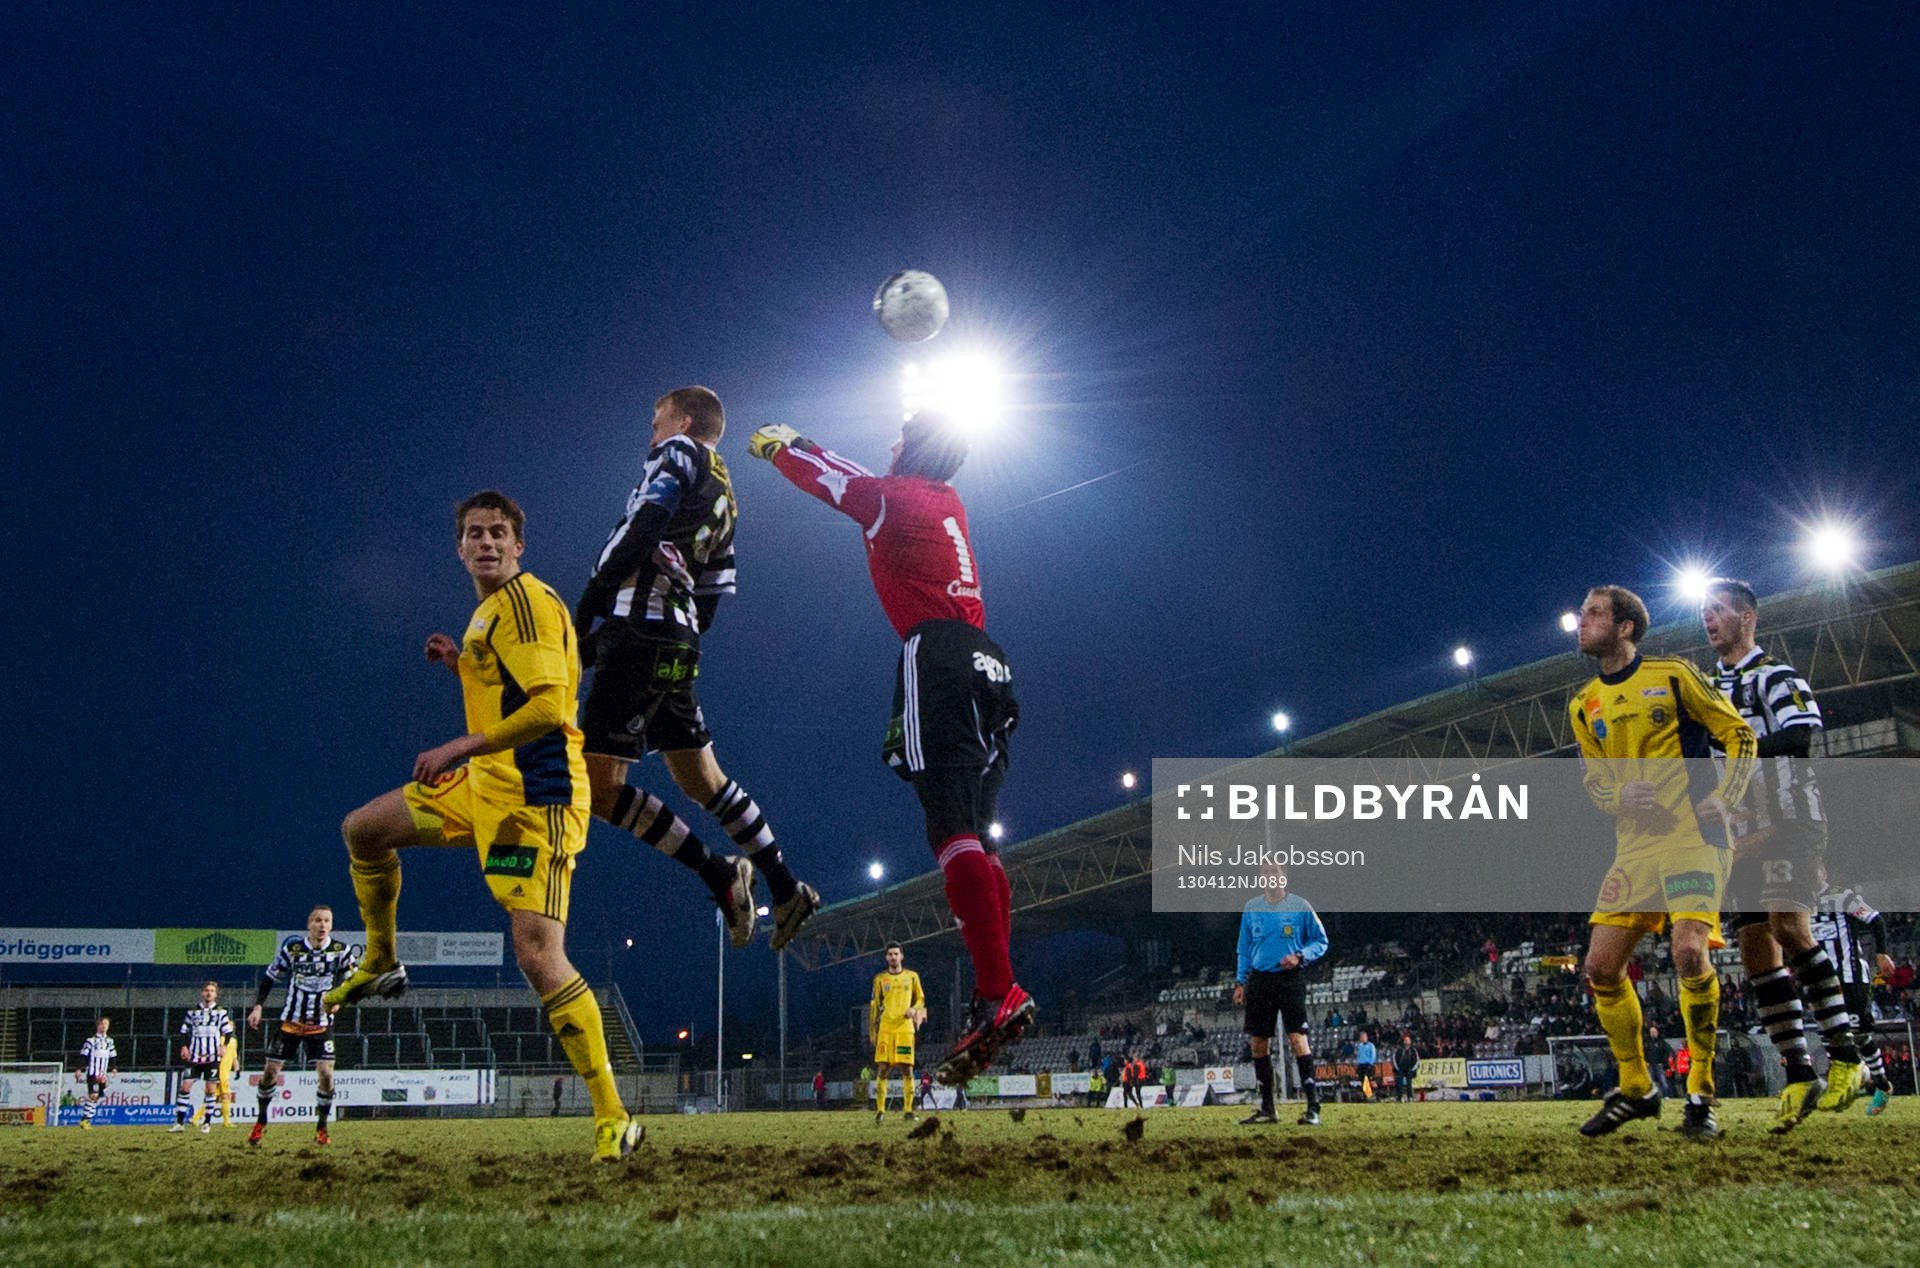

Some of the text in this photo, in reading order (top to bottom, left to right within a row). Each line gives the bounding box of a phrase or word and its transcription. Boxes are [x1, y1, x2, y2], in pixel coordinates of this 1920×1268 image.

[943, 516, 973, 583] 1
[1762, 859, 1793, 884] 13
[324, 1041, 334, 1053] 8
[210, 1069, 218, 1077] 7
[1420, 1061, 1462, 1076] ERFEKT
[1471, 1064, 1519, 1079] EURONICS
[299, 1075, 376, 1086] Huvpartners
[64, 1107, 116, 1116] PARETT
[272, 1106, 332, 1118] MOBI
